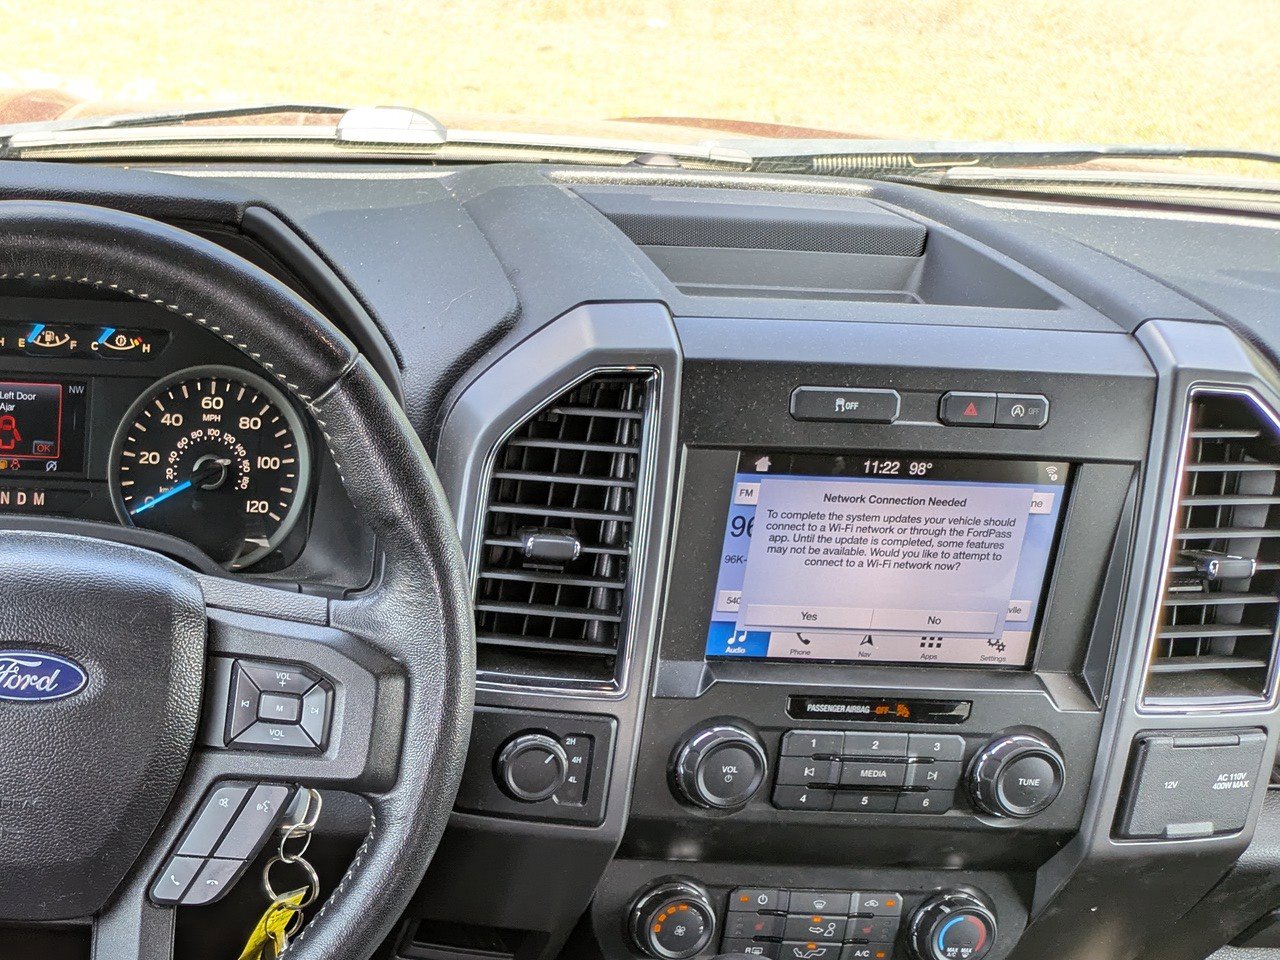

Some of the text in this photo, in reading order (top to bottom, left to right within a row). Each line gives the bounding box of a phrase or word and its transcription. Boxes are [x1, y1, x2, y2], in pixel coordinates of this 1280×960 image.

[18, 338, 25, 347] E
[70, 341, 77, 350] F
[91, 341, 98, 350] C
[142, 344, 150, 353] H
[69, 386, 85, 394] NW
[0, 391, 15, 400] Left
[16, 392, 37, 401] Door
[0, 402, 16, 412] Ajar
[201, 397, 224, 410] 60
[846, 402, 859, 411] OFF
[1028, 408, 1040, 416] OFF
[161, 414, 183, 426] 40
[202, 414, 221, 422] MPH
[238, 416, 262, 430] 80
[191, 429, 203, 439] 80
[207, 428, 220, 437] 100
[177, 436, 188, 449] 60
[223, 432, 236, 444] 120
[37, 444, 51, 452] OK
[139, 452, 160, 465] 20
[168, 450, 178, 464] 40
[257, 456, 280, 470] 100
[863, 460, 933, 476] 11:22 98°
[166, 468, 174, 480] 20
[739, 488, 754, 497] FM
[0, 491, 10, 505] N
[17, 492, 27, 505] D
[34, 492, 45, 506] M
[823, 493, 968, 508] Network Connection Needed
[246, 500, 269, 514] 120
[767, 509, 1016, 527] To complete the system updates your vehicle should
[766, 522, 806, 532] connect
[808, 524, 818, 532] to
[828, 523, 854, 533] Wi-Fi
[856, 524, 894, 534] network
[910, 526, 946, 538] through
[949, 528, 964, 537] the
[966, 528, 1012, 538] FordPass
[768, 534, 1004, 550] app. Until the update is completed, some features
[767, 546, 1002, 562] may not be available. Would you like to attempt to
[804, 558, 844, 567] connect
[846, 559, 856, 568] to
[866, 559, 891, 568] Wi-Fi
[893, 560, 932, 570] network
[934, 562, 961, 571] now?
[801, 612, 818, 622] Yes
[927, 616, 942, 626] No
[725, 646, 746, 654] Audio
[790, 648, 811, 656] Phone
[920, 653, 938, 661] Apps
[980, 654, 1006, 663] Settings
[276, 672, 291, 681] VOL
[276, 704, 284, 712] M
[806, 704, 890, 714] PASSENGER AIRBAG OFF
[269, 729, 284, 738] VOL
[565, 738, 576, 746] 2H
[810, 739, 816, 748] 1
[872, 741, 879, 750] 2
[934, 742, 940, 751] 3
[572, 756, 582, 764] 4H
[722, 766, 738, 774] VOL
[860, 770, 887, 778] MEDIA
[568, 776, 578, 784] 4L
[1217, 772, 1248, 782] AC 110V
[1018, 778, 1040, 786] TUNE
[1164, 781, 1178, 789] 12V
[1212, 780, 1250, 790] 400W MAX
[800, 794, 807, 802] 4
[861, 796, 868, 805] 5
[922, 798, 930, 807] 6
[854, 950, 870, 958] A/C
